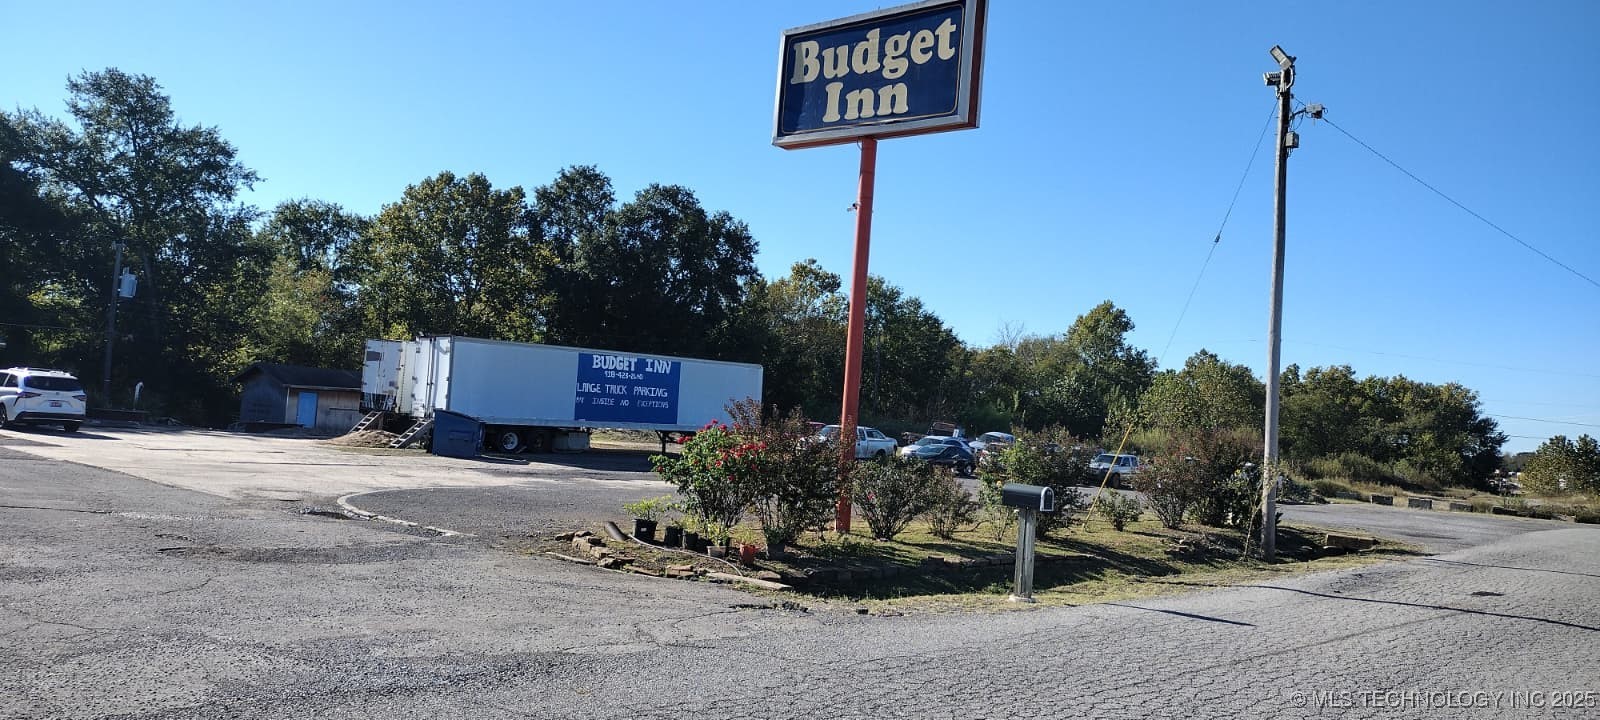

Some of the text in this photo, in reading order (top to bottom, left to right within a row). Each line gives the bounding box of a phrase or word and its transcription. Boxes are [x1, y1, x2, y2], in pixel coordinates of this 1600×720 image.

[790, 18, 957, 84] Budget
[822, 82, 909, 123] Inn
[592, 354, 672, 374] BUDGET INN
[576, 382, 668, 398] LARGE TRUCK PARKING
[592, 397, 615, 406] INSIDE
[619, 399, 630, 407] NO
